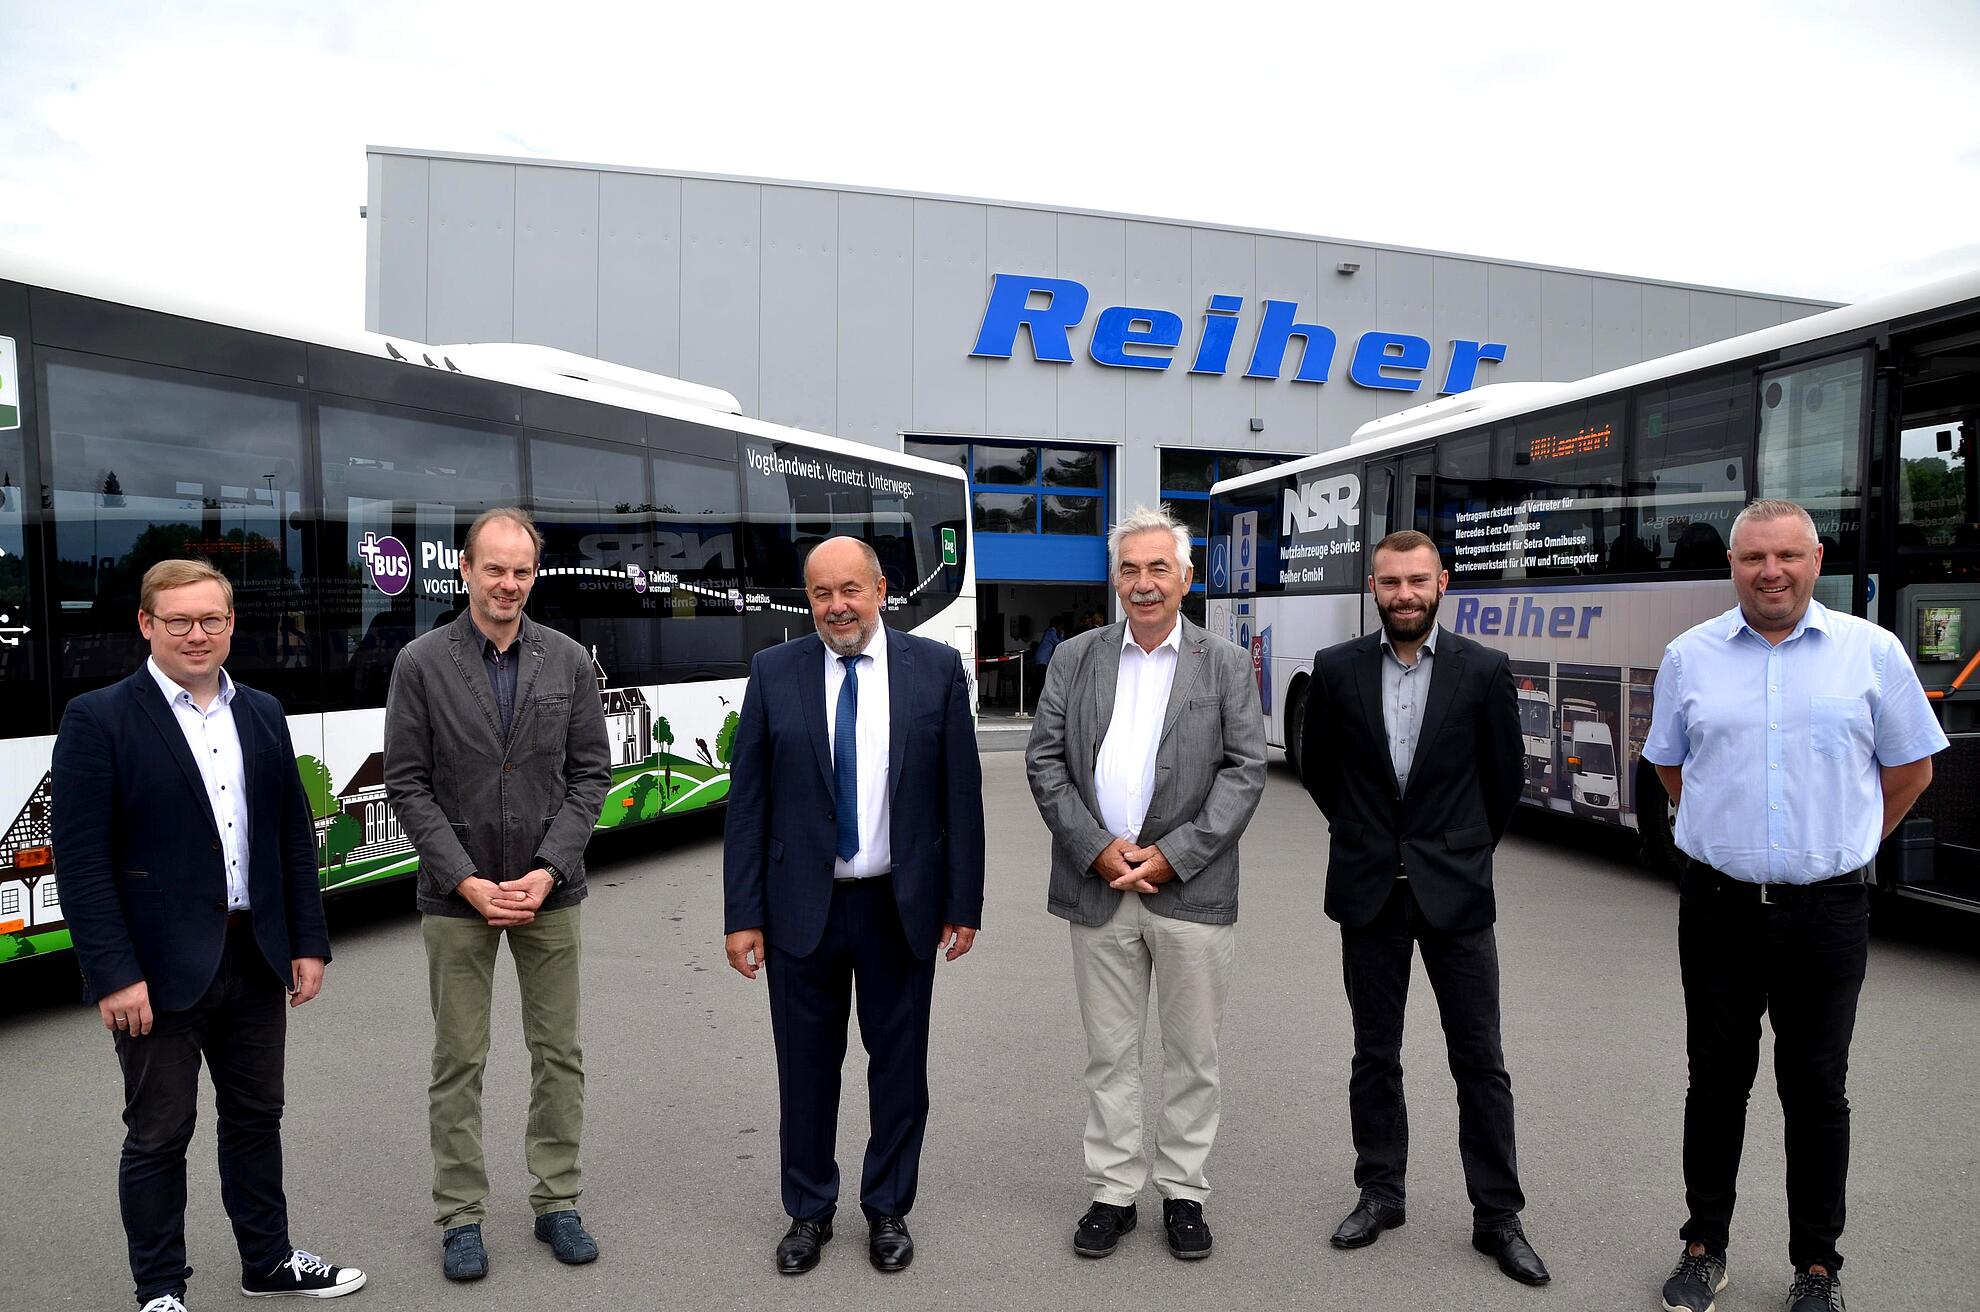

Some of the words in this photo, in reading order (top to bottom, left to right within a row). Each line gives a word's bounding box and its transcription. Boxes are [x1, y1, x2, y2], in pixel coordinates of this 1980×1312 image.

[968, 272, 1507, 395] Reiher
[747, 448, 825, 480] Vogtlandweit.
[825, 463, 867, 488] Vernetzt.
[868, 472, 914, 499] Unterwegs.
[1282, 474, 1361, 537] NSR
[1456, 506, 1513, 523] Vertragswerkstatt
[1513, 504, 1527, 515] und
[1528, 500, 1561, 513] Vertreter
[1562, 497, 1574, 508] für
[1455, 527, 1485, 539] Mercedes
[1503, 521, 1541, 534] Omnibusse
[944, 539, 955, 554] Zug
[1280, 543, 1328, 560] Nutzfahrzeuge
[1330, 539, 1361, 555] Service
[1455, 541, 1512, 556] Vertragswerkstatt
[1513, 540, 1523, 550] für
[1523, 539, 1543, 549] Setra
[1544, 535, 1586, 547] Omnibusse
[1454, 560, 1508, 572] Servicewerkstatt
[1509, 558, 1519, 568] für
[1520, 556, 1537, 567] LKW
[1538, 555, 1551, 566] und
[1552, 552, 1599, 567] Transporter
[634, 577, 646, 586] BUS
[648, 570, 679, 584] TaktBus
[1280, 569, 1301, 583] Reiher
[1302, 567, 1324, 582] GmbH
[423, 579, 470, 594] VOGTLA
[648, 585, 671, 593] VOGTLAND
[745, 593, 771, 604] StadtBus
[1454, 596, 1603, 640] Reiher
